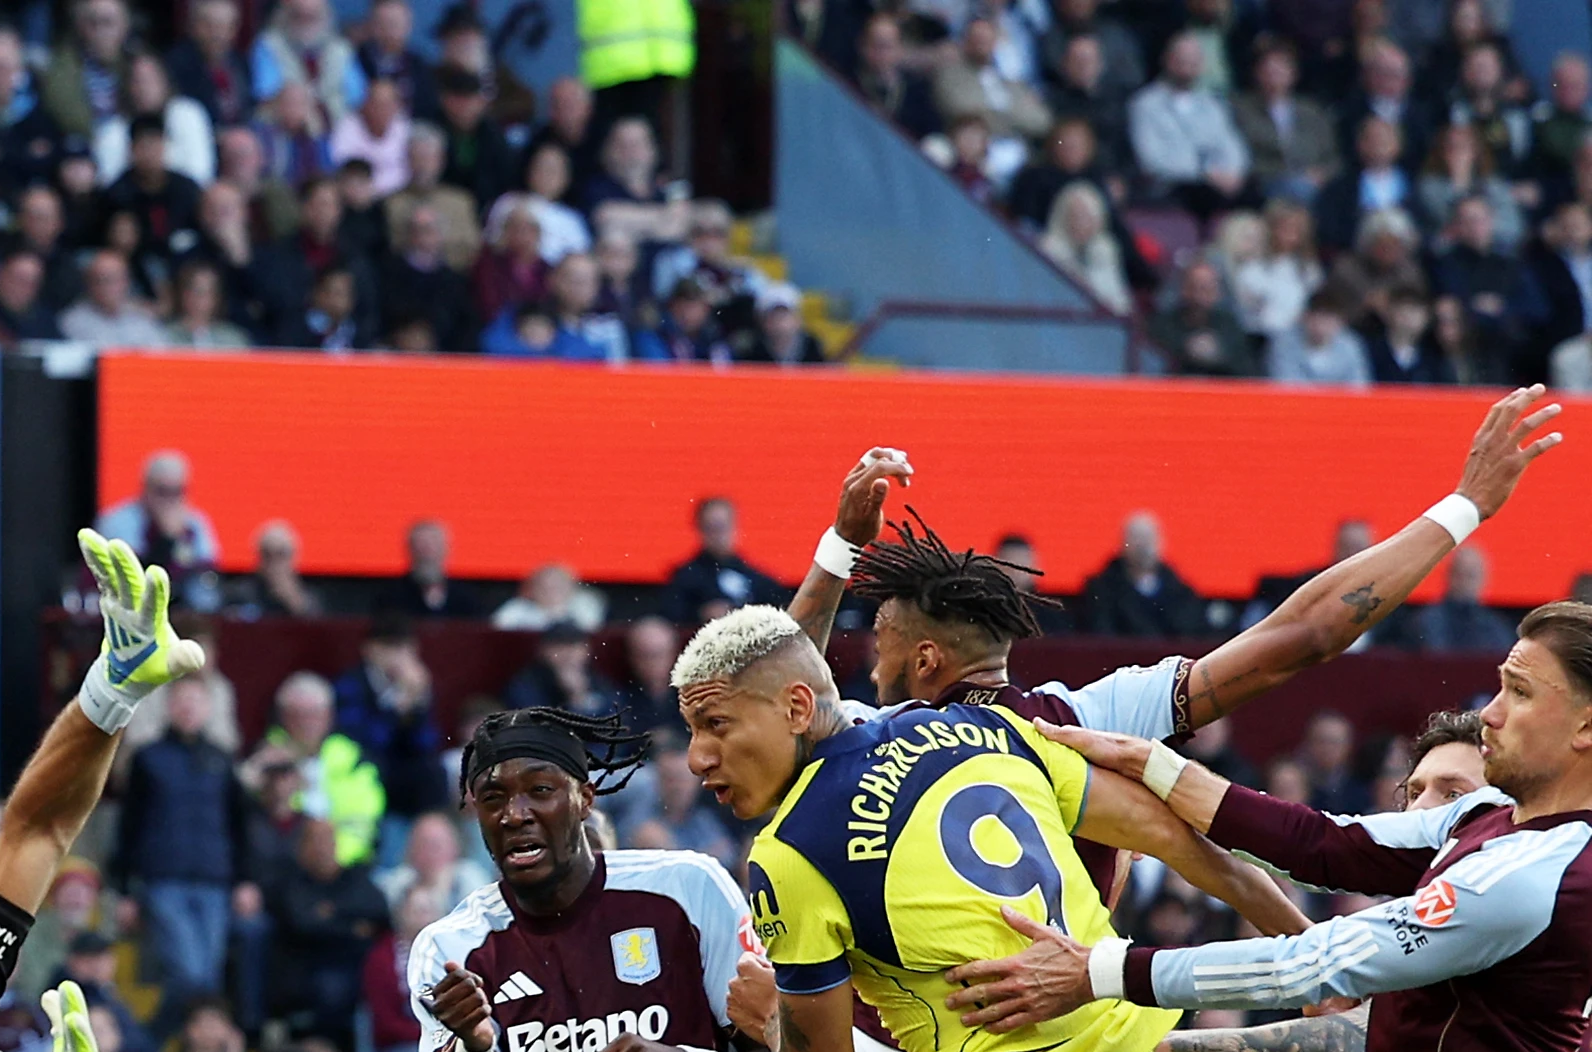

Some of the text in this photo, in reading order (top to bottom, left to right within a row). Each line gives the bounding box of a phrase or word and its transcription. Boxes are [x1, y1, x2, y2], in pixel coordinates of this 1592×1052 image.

[847, 720, 1010, 861] RICHARLISON
[937, 782, 1070, 936] 9
[1385, 905, 1415, 956] NTION
